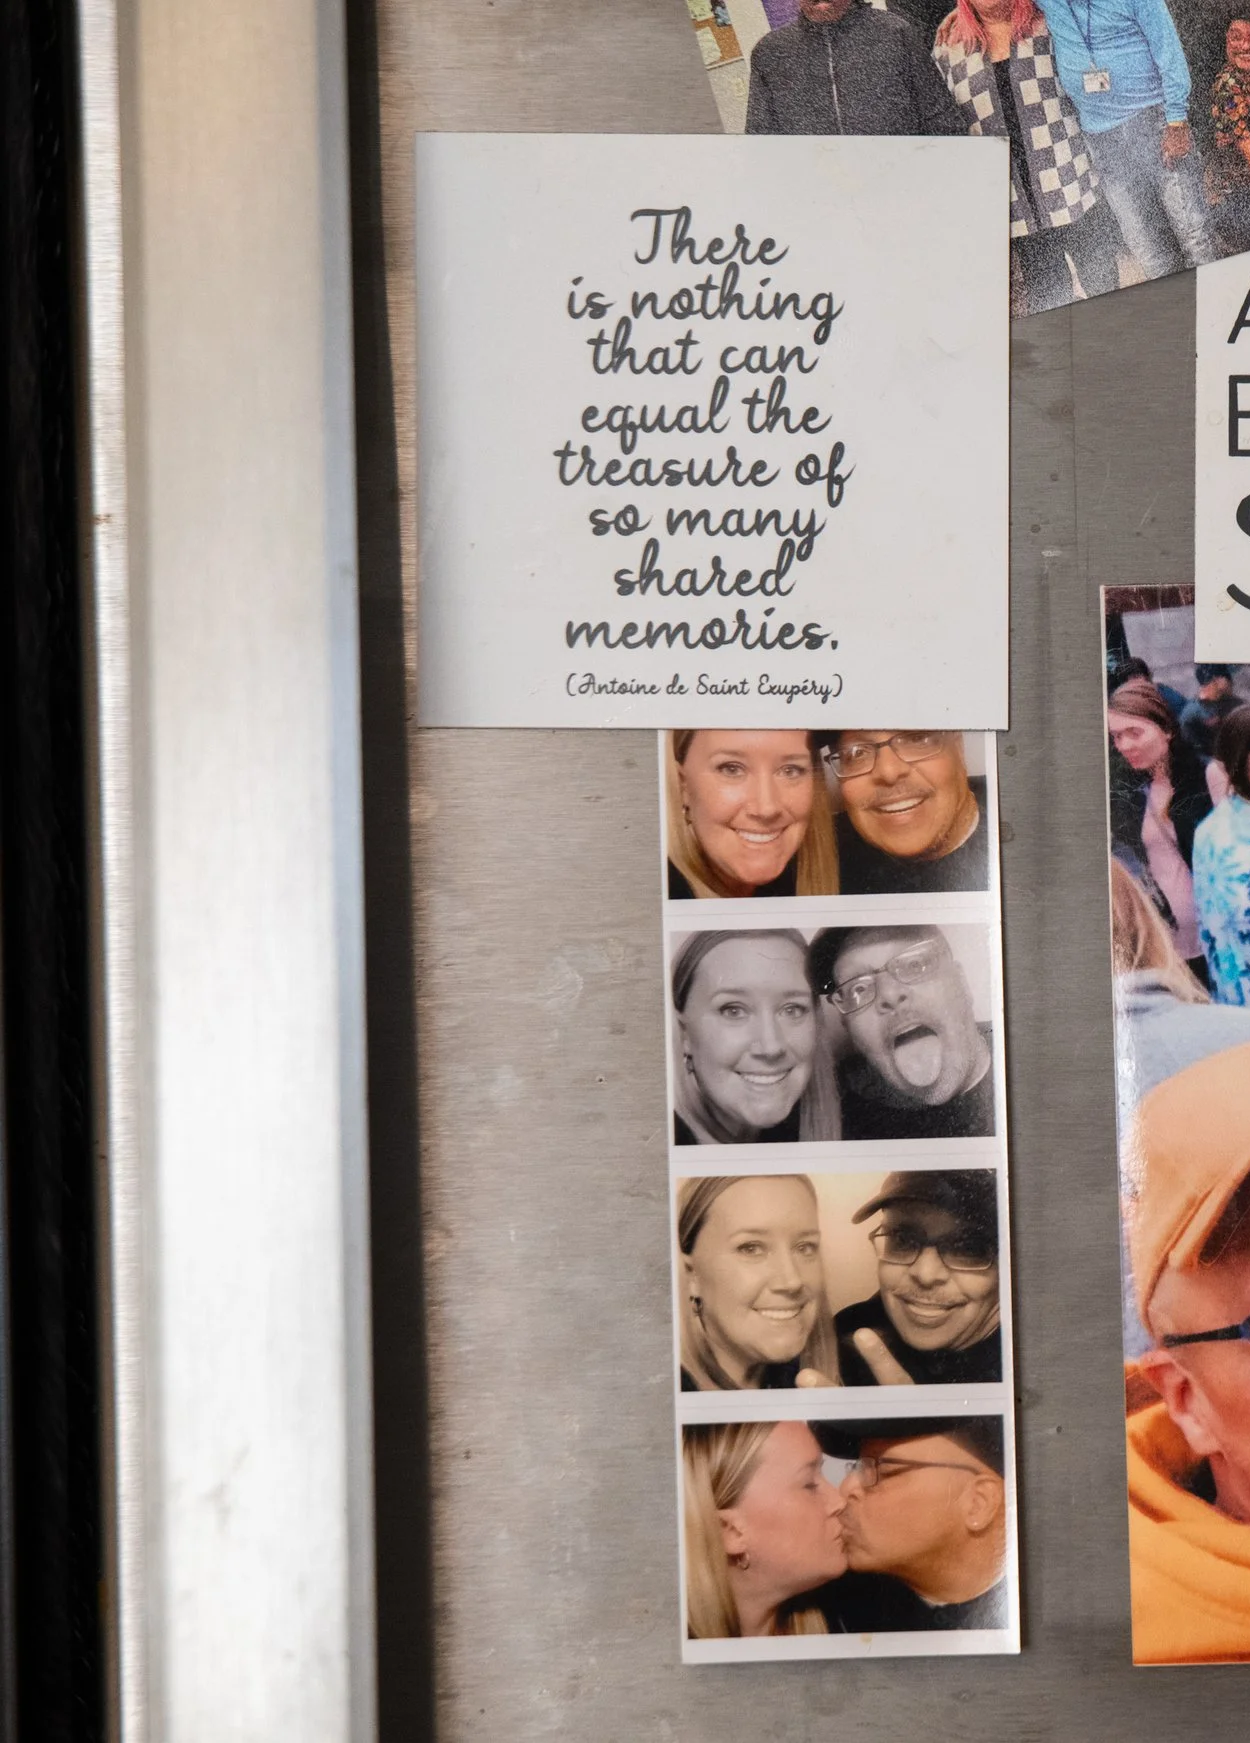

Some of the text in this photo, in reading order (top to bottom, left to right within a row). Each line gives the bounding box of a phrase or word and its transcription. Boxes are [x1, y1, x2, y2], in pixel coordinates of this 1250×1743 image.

[630, 205, 789, 266] There
[567, 260, 844, 346] is nothing
[586, 315, 819, 376] that can
[581, 374, 833, 456] equal the
[552, 440, 855, 509] treasure of
[588, 503, 826, 562] so many
[613, 537, 796, 597] shared
[565, 606, 839, 651] memories.
[566, 672, 843, 705] (Antoine de Saint Exupéry)
